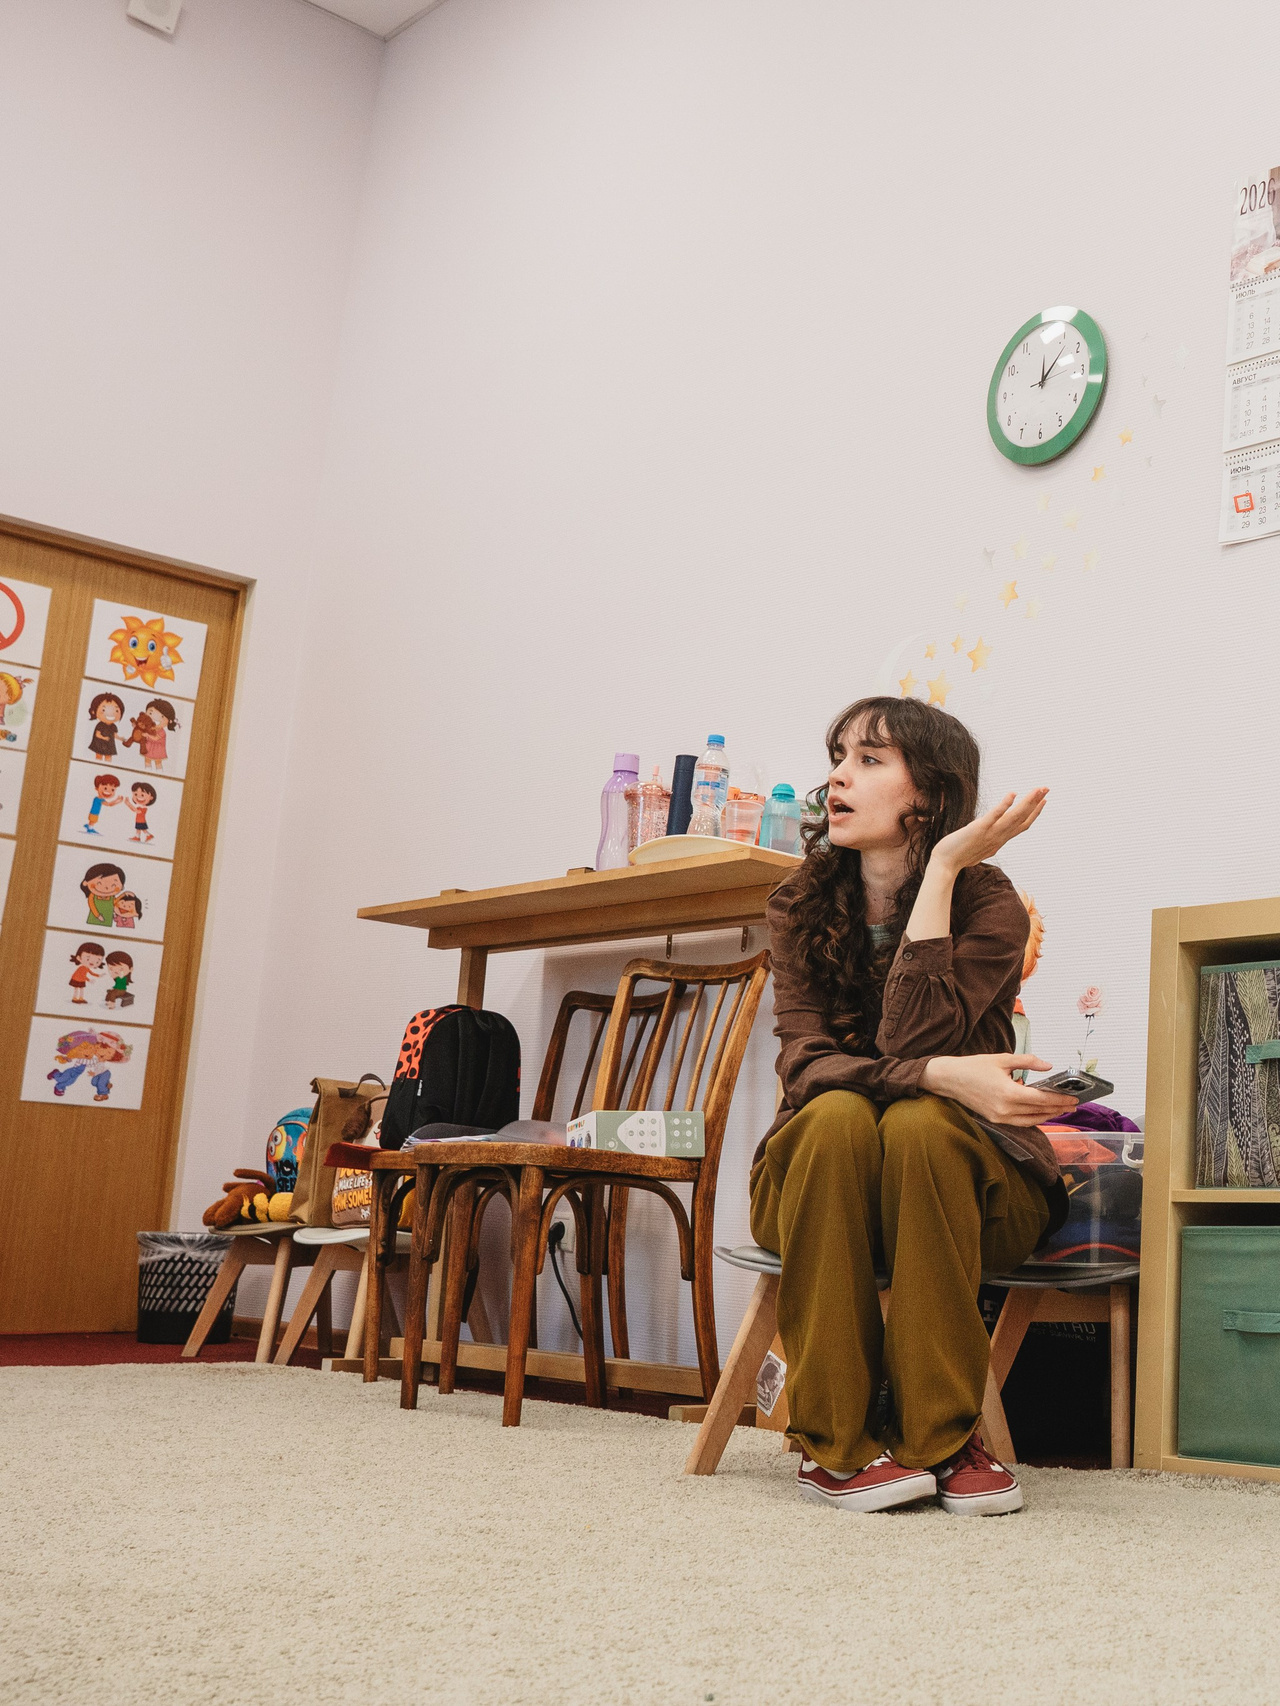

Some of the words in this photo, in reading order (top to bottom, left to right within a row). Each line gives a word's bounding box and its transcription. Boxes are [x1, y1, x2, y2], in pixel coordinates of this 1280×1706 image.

[1240, 178, 1275, 215] 2026
[1235, 289, 1256, 299] ИЮЛЬ
[1249, 312, 1254, 320] 6
[1248, 321, 1255, 329] 13
[1246, 331, 1255, 340] 20
[1263, 326, 1270, 335] 21
[1022, 343, 1029, 354] 11
[1075, 342, 1081, 354] 2
[1246, 341, 1254, 350] 27
[1262, 336, 1270, 345] 28
[1007, 365, 1016, 377] 10
[1081, 364, 1085, 375] 3
[1232, 373, 1257, 385] АВГУСТ
[1003, 392, 1007, 403] 9
[1073, 393, 1078, 404] 4
[1246, 399, 1251, 407] 3
[1261, 404, 1267, 412] 11
[1007, 415, 1012, 427] 8
[1058, 415, 1063, 428] 5
[1244, 419, 1251, 427] 17
[1260, 414, 1267, 422] 18
[1019, 428, 1024, 440] 7
[1038, 428, 1043, 440] 6
[1259, 424, 1267, 433] 25
[1230, 465, 1251, 475] ИЮНЬ
[1261, 475, 1265, 483] 2
[1260, 485, 1266, 493] 9
[1259, 495, 1267, 504] 16
[1258, 505, 1267, 515] 23
[1241, 520, 1250, 529] 29
[1258, 516, 1267, 525] 30
[338, 1178, 353, 1191] MAKE
[353, 1175, 367, 1189] LIFE
